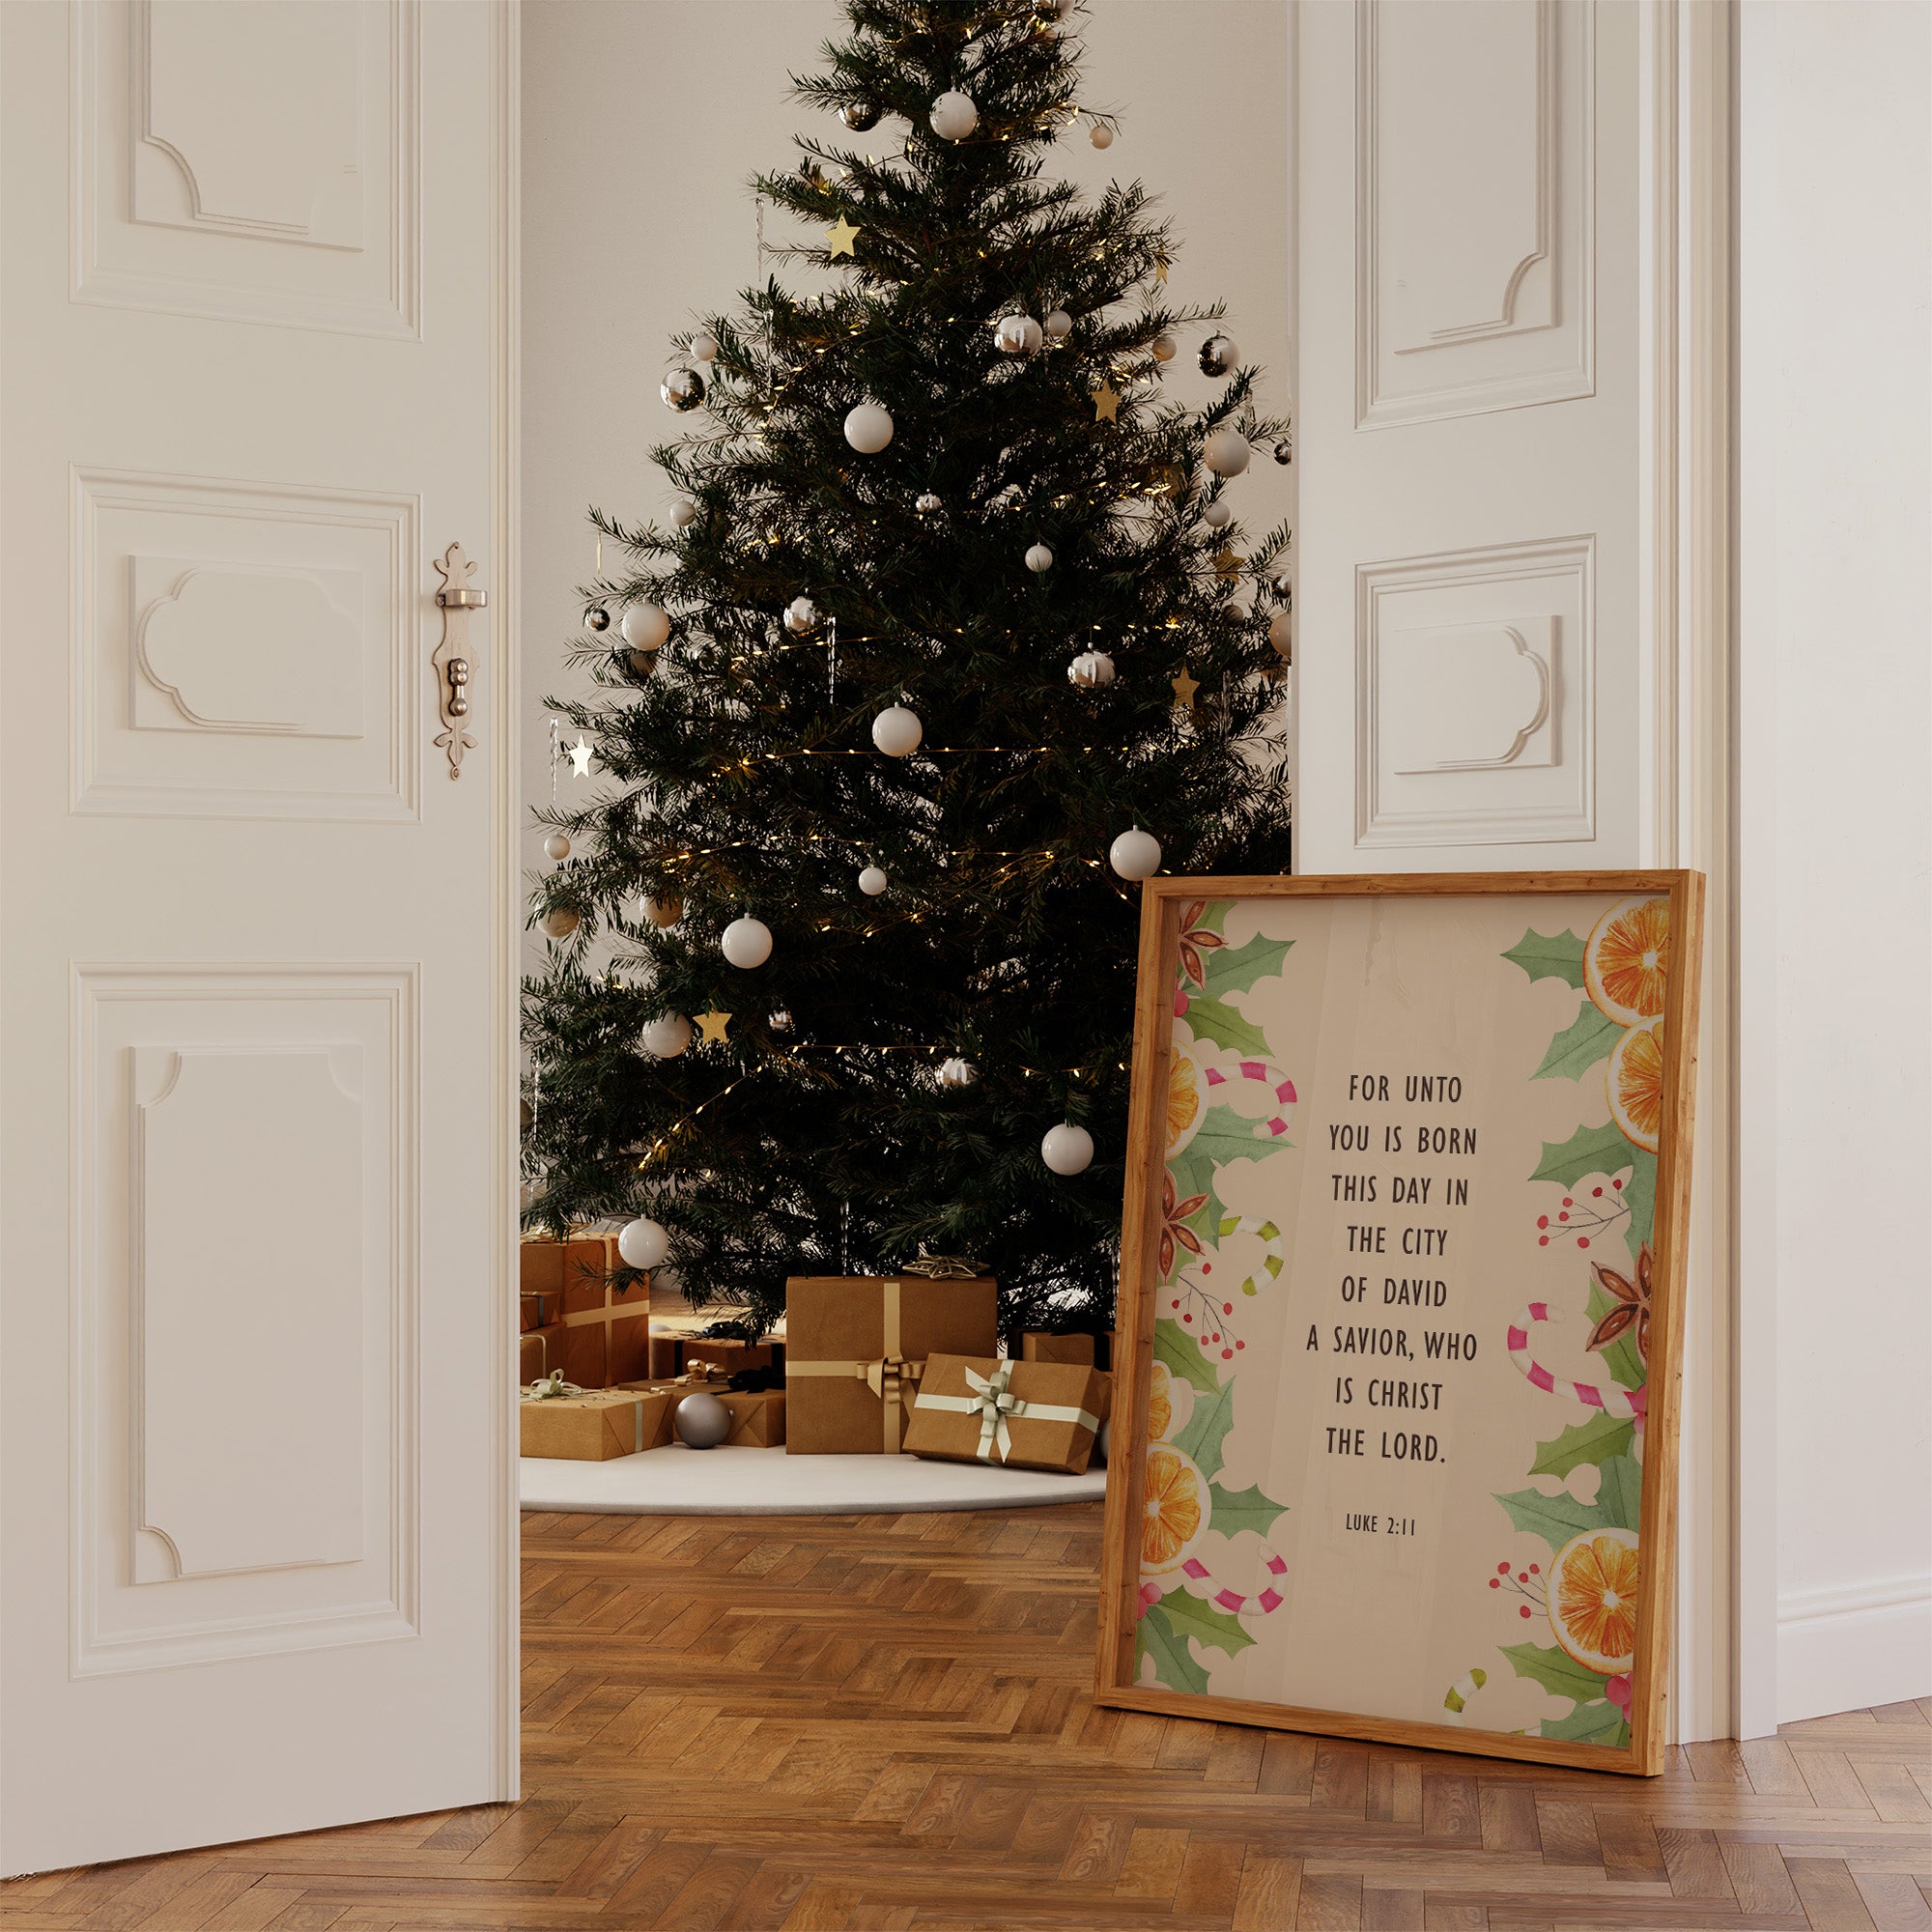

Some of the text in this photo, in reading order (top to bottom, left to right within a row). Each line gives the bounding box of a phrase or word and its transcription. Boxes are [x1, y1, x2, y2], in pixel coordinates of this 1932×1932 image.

[1349, 1074, 1463, 1103] FOR UNTO
[1328, 1123, 1477, 1155] YOU IS BORN
[1331, 1174, 1469, 1207] THIS DAY IN
[1347, 1225, 1448, 1257] THE CITY
[1341, 1274, 1447, 1308] OF DAVID
[1305, 1323, 1478, 1362] A SAVIOR, WHO
[1335, 1377, 1443, 1410] IS CHRIST
[1325, 1427, 1446, 1463] THE LORD.
[1346, 1513, 1415, 1537] LUKE 2:11
